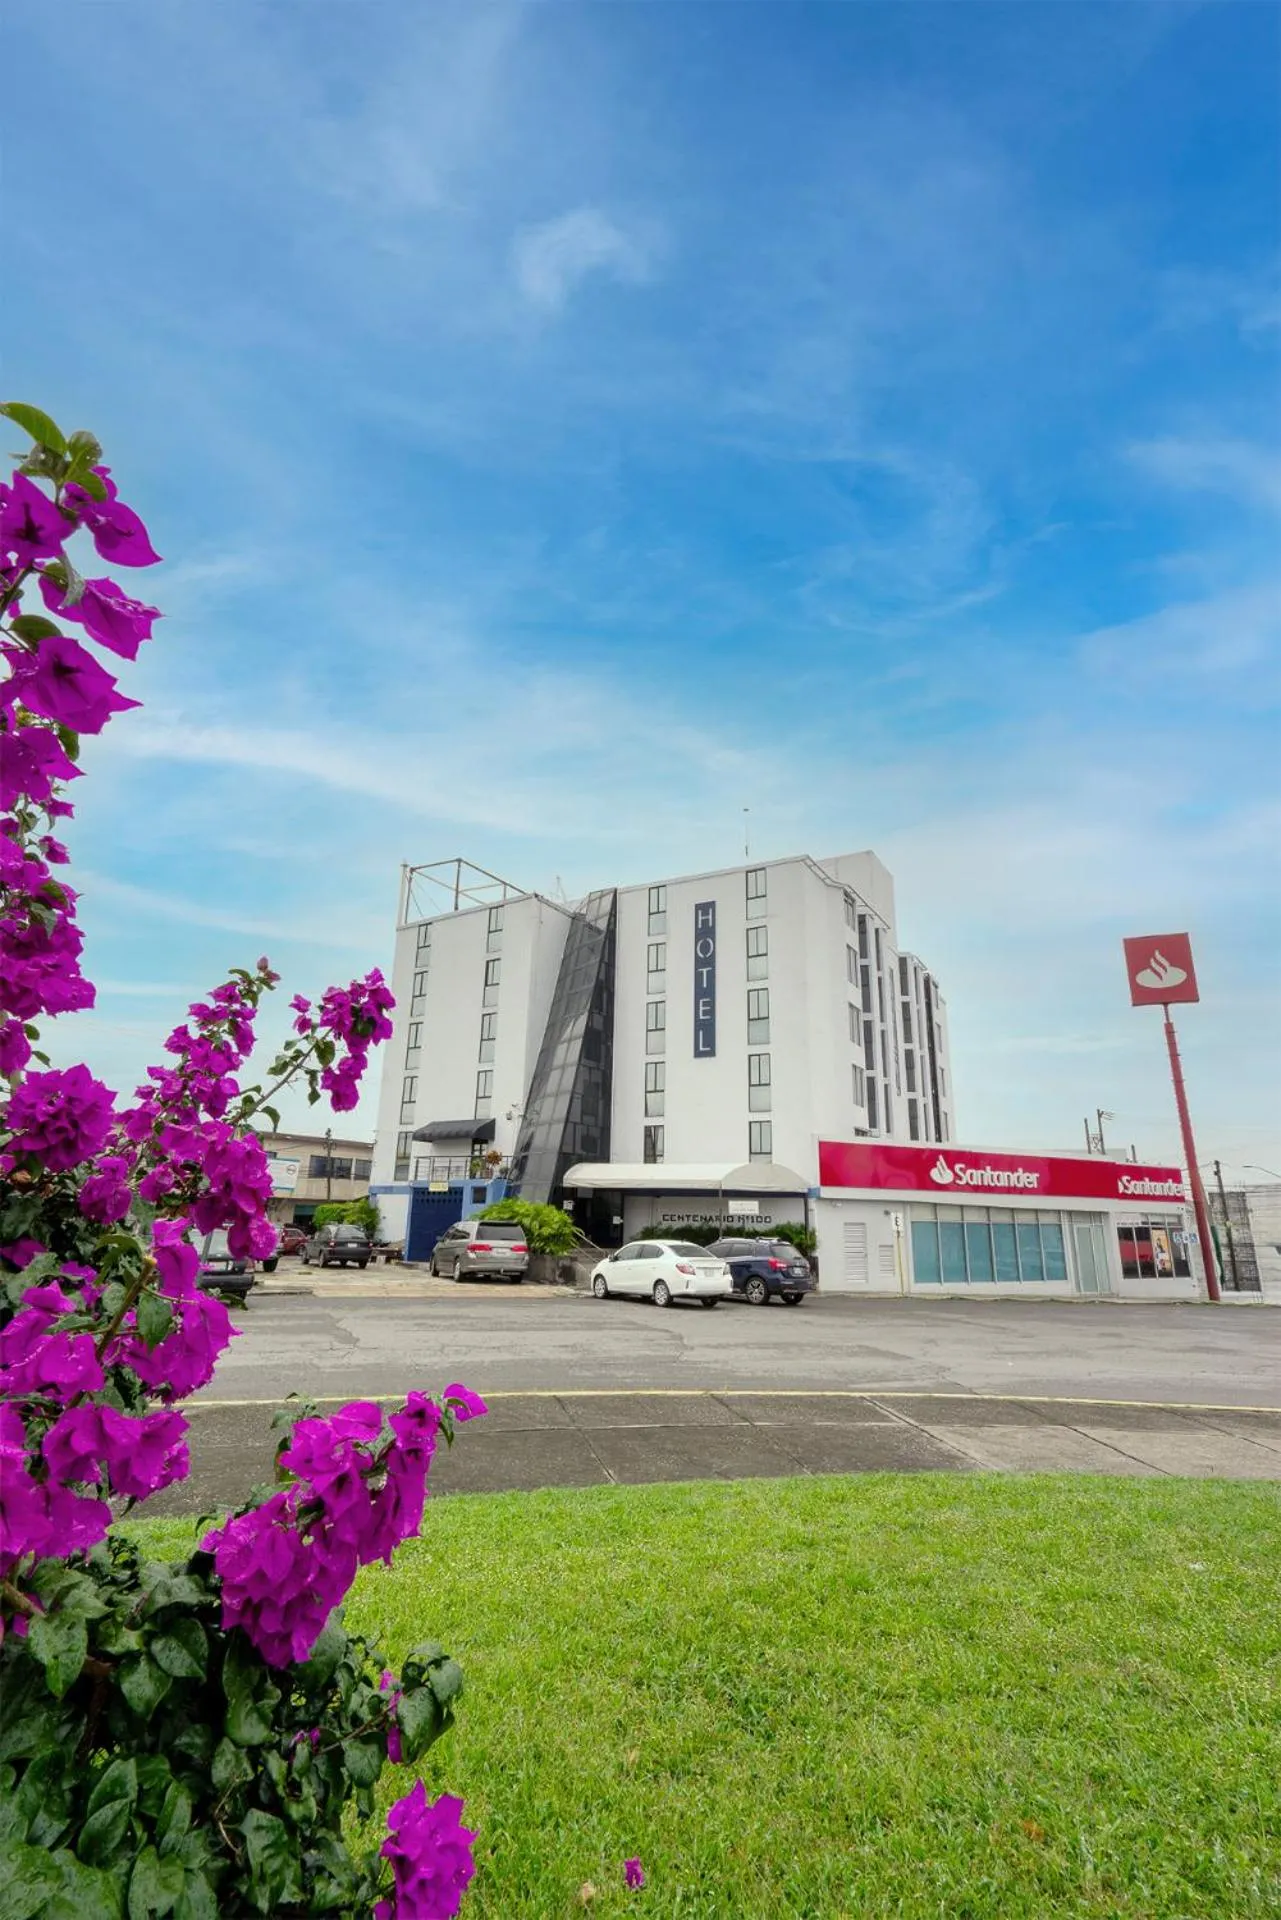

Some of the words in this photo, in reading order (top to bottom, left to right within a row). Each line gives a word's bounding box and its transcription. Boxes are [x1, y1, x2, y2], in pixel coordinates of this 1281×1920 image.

[696, 908, 714, 1051] HOTEL
[954, 1163, 1040, 1188] Santander
[662, 1214, 734, 1223] CENTENARIO
